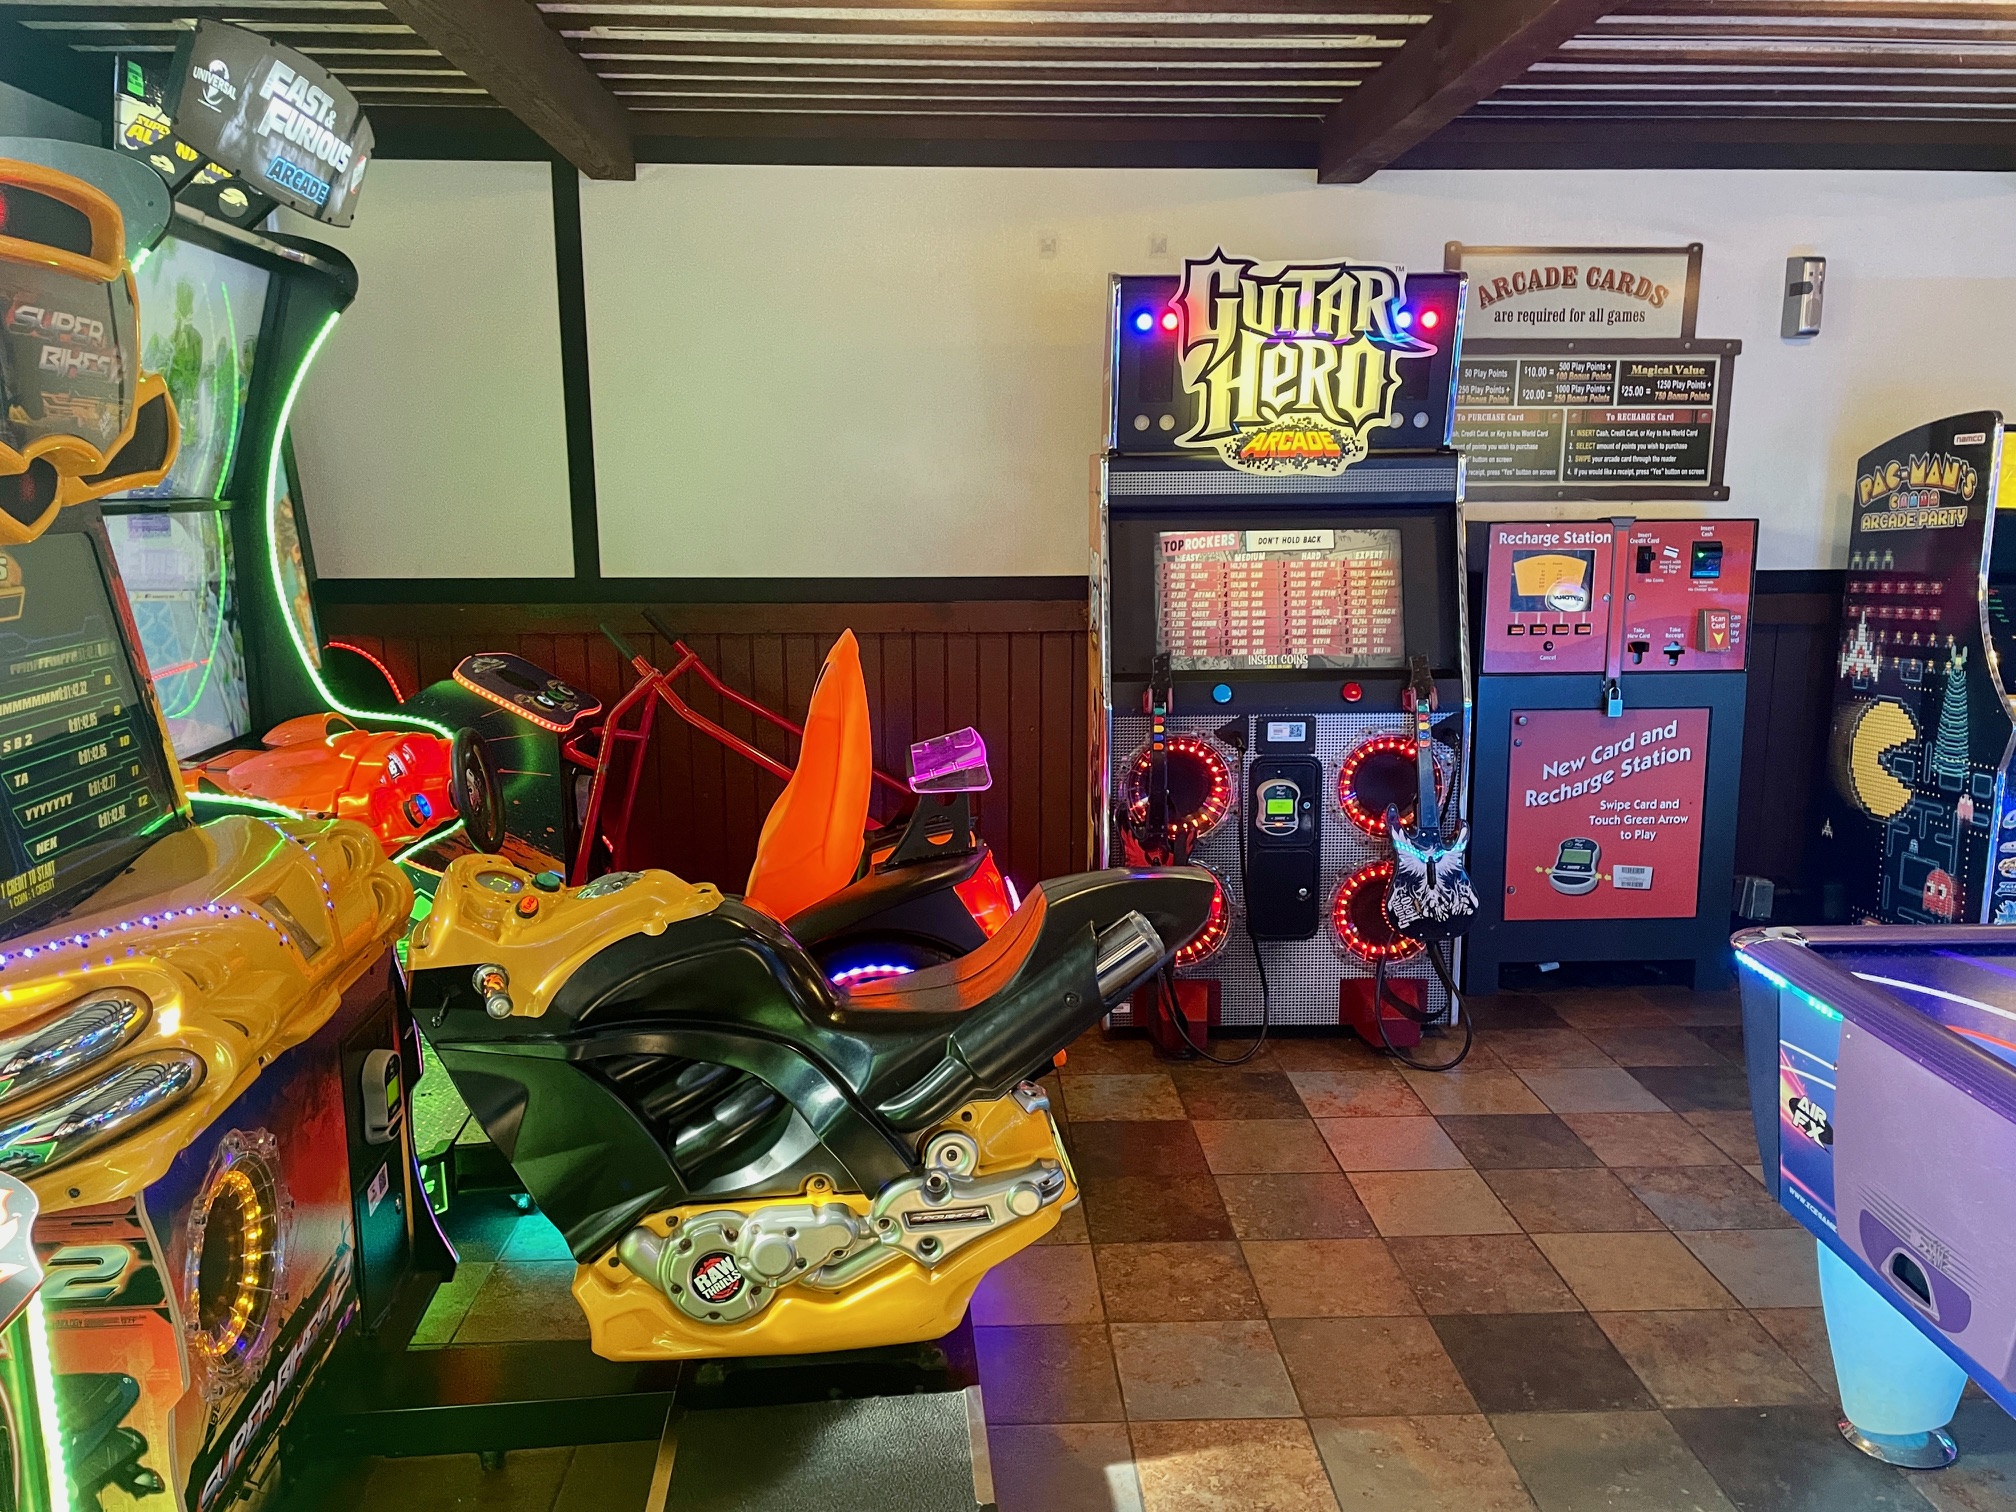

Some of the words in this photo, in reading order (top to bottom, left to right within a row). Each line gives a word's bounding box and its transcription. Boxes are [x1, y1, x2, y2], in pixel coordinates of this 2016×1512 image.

[192, 65, 238, 101] UNIVERSAL
[259, 59, 335, 123] FAST
[325, 110, 337, 130] &
[257, 96, 352, 174] FURIOUS
[267, 157, 330, 204] ARCADE
[1478, 265, 1578, 309] ARCADE
[1586, 265, 1670, 309] CARDS
[1182, 254, 1412, 354] GUITAR
[1494, 311, 1514, 323] are
[1517, 308, 1566, 325] required
[1569, 308, 1586, 323] for
[1589, 308, 1604, 323] all
[1607, 311, 1646, 325] games
[14, 305, 104, 341] SUPER
[1525, 366, 1547, 378] $10.00
[1559, 362, 1570, 371] 500
[1571, 362, 1586, 372] Play
[1586, 362, 1606, 371] Points
[1631, 365, 1672, 377] Magical
[1675, 365, 1706, 375] Value
[1465, 369, 1473, 378] 50
[1473, 369, 1487, 379] Play
[1488, 369, 1508, 378] Points
[1556, 372, 1568, 381] 100
[1568, 372, 1590, 381] Bonus
[1591, 372, 1612, 380] Points
[1471, 385, 1484, 395] Play
[1485, 386, 1505, 394] Points
[1556, 385, 1570, 393] 1000
[1571, 384, 1586, 395] Play
[1586, 384, 1606, 393] Points
[1621, 385, 1644, 397] $25.00
[1657, 380, 1671, 389] 1250
[1672, 380, 1687, 391] Play
[1688, 380, 1707, 389] Points
[1523, 389, 1545, 400] $20.00
[1567, 394, 1588, 403] Bonus
[1589, 394, 1610, 403] Points
[1654, 391, 1667, 401] 750
[1667, 392, 1689, 401] Bonus
[1689, 392, 1711, 401] Points
[1457, 413, 1466, 421] To
[1467, 413, 1505, 421] PURCHASE
[1507, 413, 1524, 421] Card
[1606, 413, 1615, 421] To
[1617, 413, 1656, 421] RECHARGE
[1657, 413, 1674, 421] Card
[1576, 429, 1596, 437] INSERT
[1610, 429, 1625, 437] Credit
[1646, 429, 1656, 438] Key
[1662, 429, 1671, 437] the
[1671, 429, 1686, 437] World
[1686, 429, 1699, 437] Card
[1956, 435, 1983, 443] namco
[1240, 432, 1342, 458] ARCADE
[1576, 442, 1596, 450] SELECT
[1615, 442, 1621, 450] of
[1621, 443, 1636, 451] points
[1665, 443, 1688, 451] purchase
[1632, 456, 1652, 464] through
[1858, 453, 1977, 506] PAC-MAN'S
[1862, 511, 1916, 531] ARCADE
[1919, 508, 1967, 526] PARTY
[1164, 540, 1184, 552] TOP
[1185, 534, 1235, 550] ROCKERS
[1258, 537, 1279, 545] DON'T
[1303, 536, 1321, 544] BACK
[1499, 532, 1559, 546] Recharge
[1563, 531, 1612, 544] Station
[1181, 553, 1200, 561] EASY
[1234, 552, 1266, 562] MEDIUM
[1302, 552, 1321, 560] HARD
[1356, 551, 1383, 559] EXPERT
[1249, 655, 1278, 665] INSERT
[1281, 654, 1308, 665] COINS
[113, 705, 121, 716] 9
[120, 735, 130, 747] 10
[1542, 756, 1585, 780] New
[1590, 732, 1635, 765] Card
[1640, 720, 1678, 746] and
[14, 772, 29, 787] TA
[1525, 769, 1614, 807] Recharge
[1620, 746, 1691, 778] Station
[138, 795, 148, 807] 12
[1600, 800, 1631, 812] Swipe
[1633, 800, 1657, 810] Card
[1660, 799, 1680, 809] and
[1589, 815, 1621, 825] Touch
[1623, 815, 1655, 825] Green
[1658, 815, 1689, 824] Arrow
[1620, 831, 1632, 840] to
[1634, 830, 1657, 842] Play
[36, 836, 57, 856] NEK
[6, 873, 27, 897] CREDIT
[27, 869, 36, 886] TO
[37, 860, 55, 881] START
[1797, 1096, 1827, 1127] AIR
[1792, 1109, 1825, 1149] FX
[41, 1245, 130, 1300] 2
[693, 1256, 735, 1292] RAW
[702, 1269, 742, 1299] THRILLS
